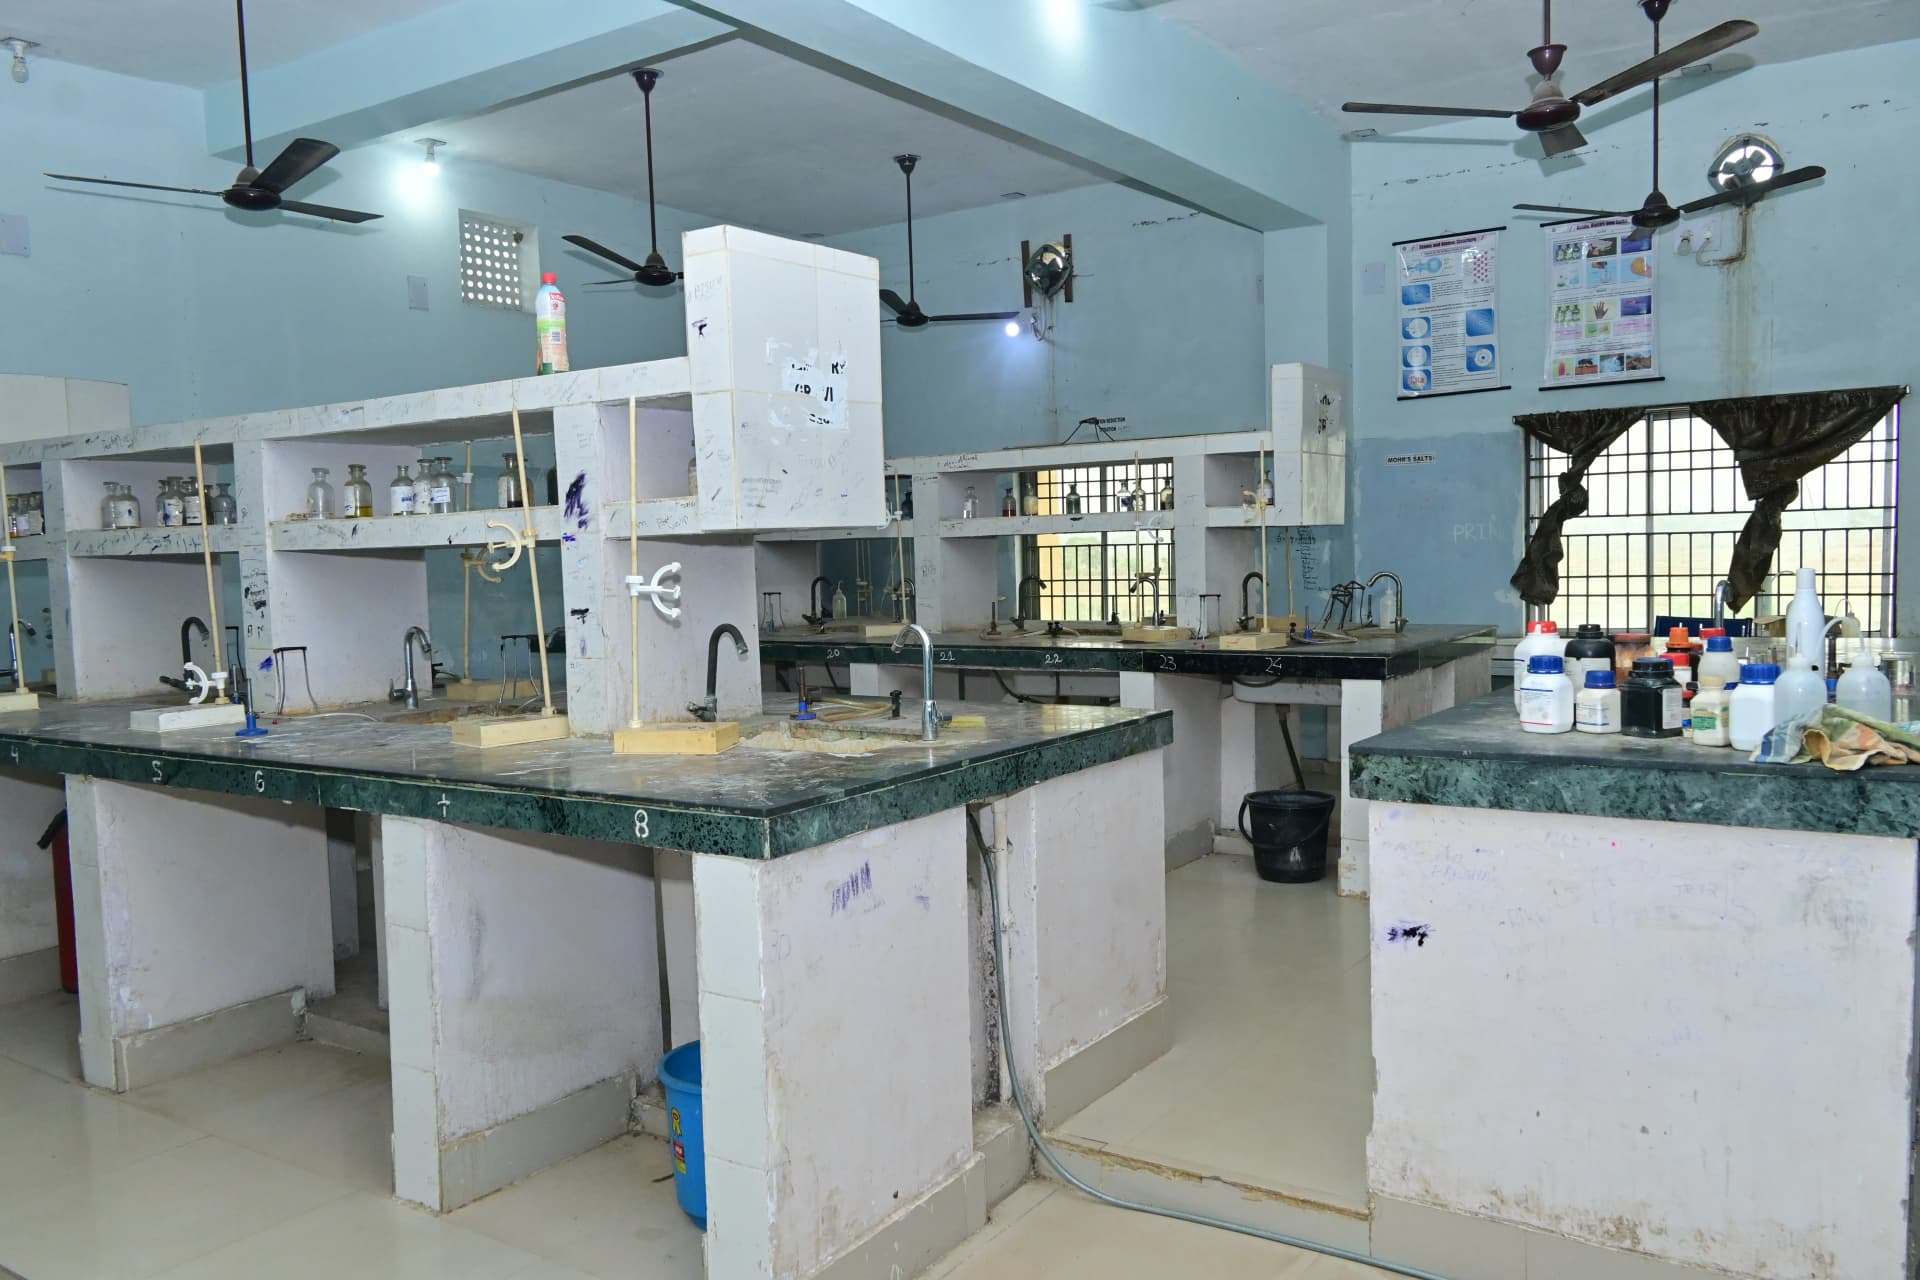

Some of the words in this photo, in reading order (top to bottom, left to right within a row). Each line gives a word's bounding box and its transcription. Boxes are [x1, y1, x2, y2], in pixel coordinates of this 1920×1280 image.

[826, 648, 841, 660] 20
[939, 651, 956, 662] 21
[1044, 653, 1064, 665] 22
[1159, 654, 1177, 671] 23
[1264, 656, 1283, 675] 24
[10, 744, 20, 766] 4
[151, 759, 163, 784] 5
[254, 770, 265, 793] 6
[634, 809, 649, 838] 8
